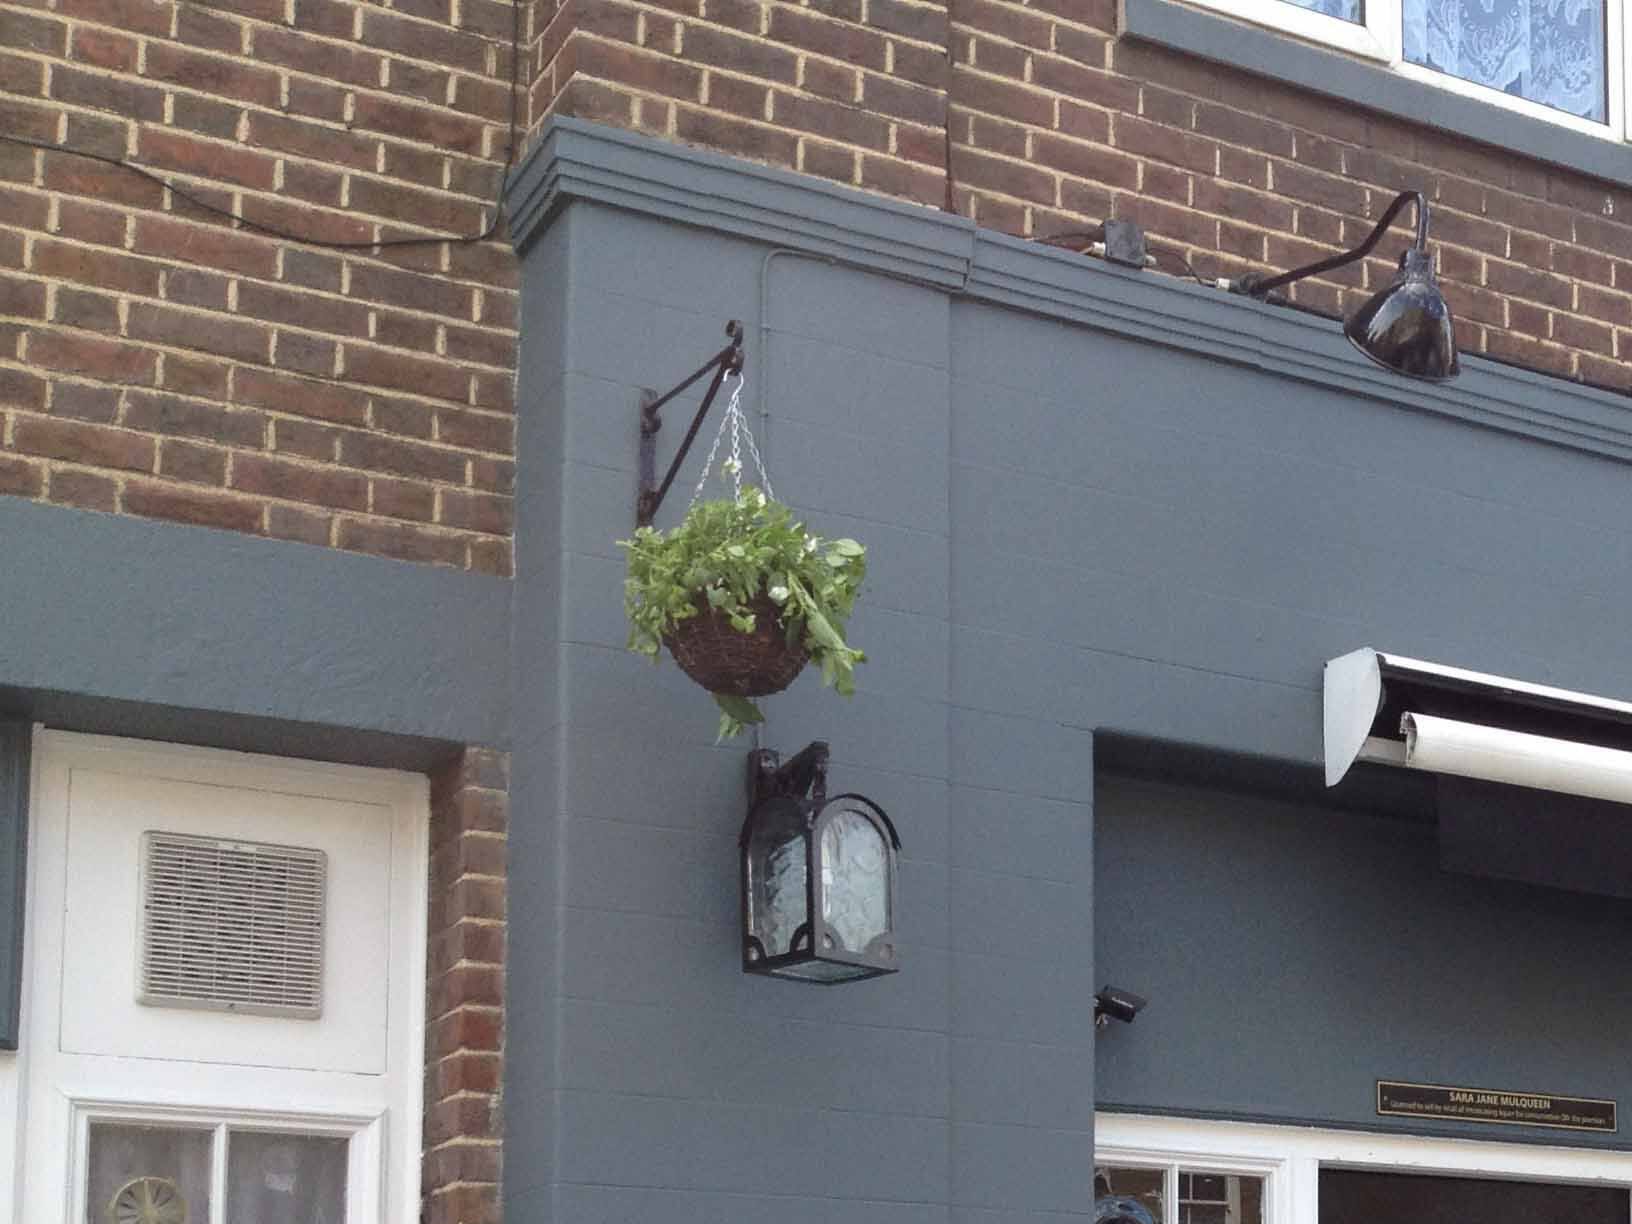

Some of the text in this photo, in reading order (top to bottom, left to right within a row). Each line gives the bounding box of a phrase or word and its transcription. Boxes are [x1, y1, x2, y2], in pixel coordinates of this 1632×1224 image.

[1449, 1091, 1551, 1110] SARA JANE MULQUEEN
